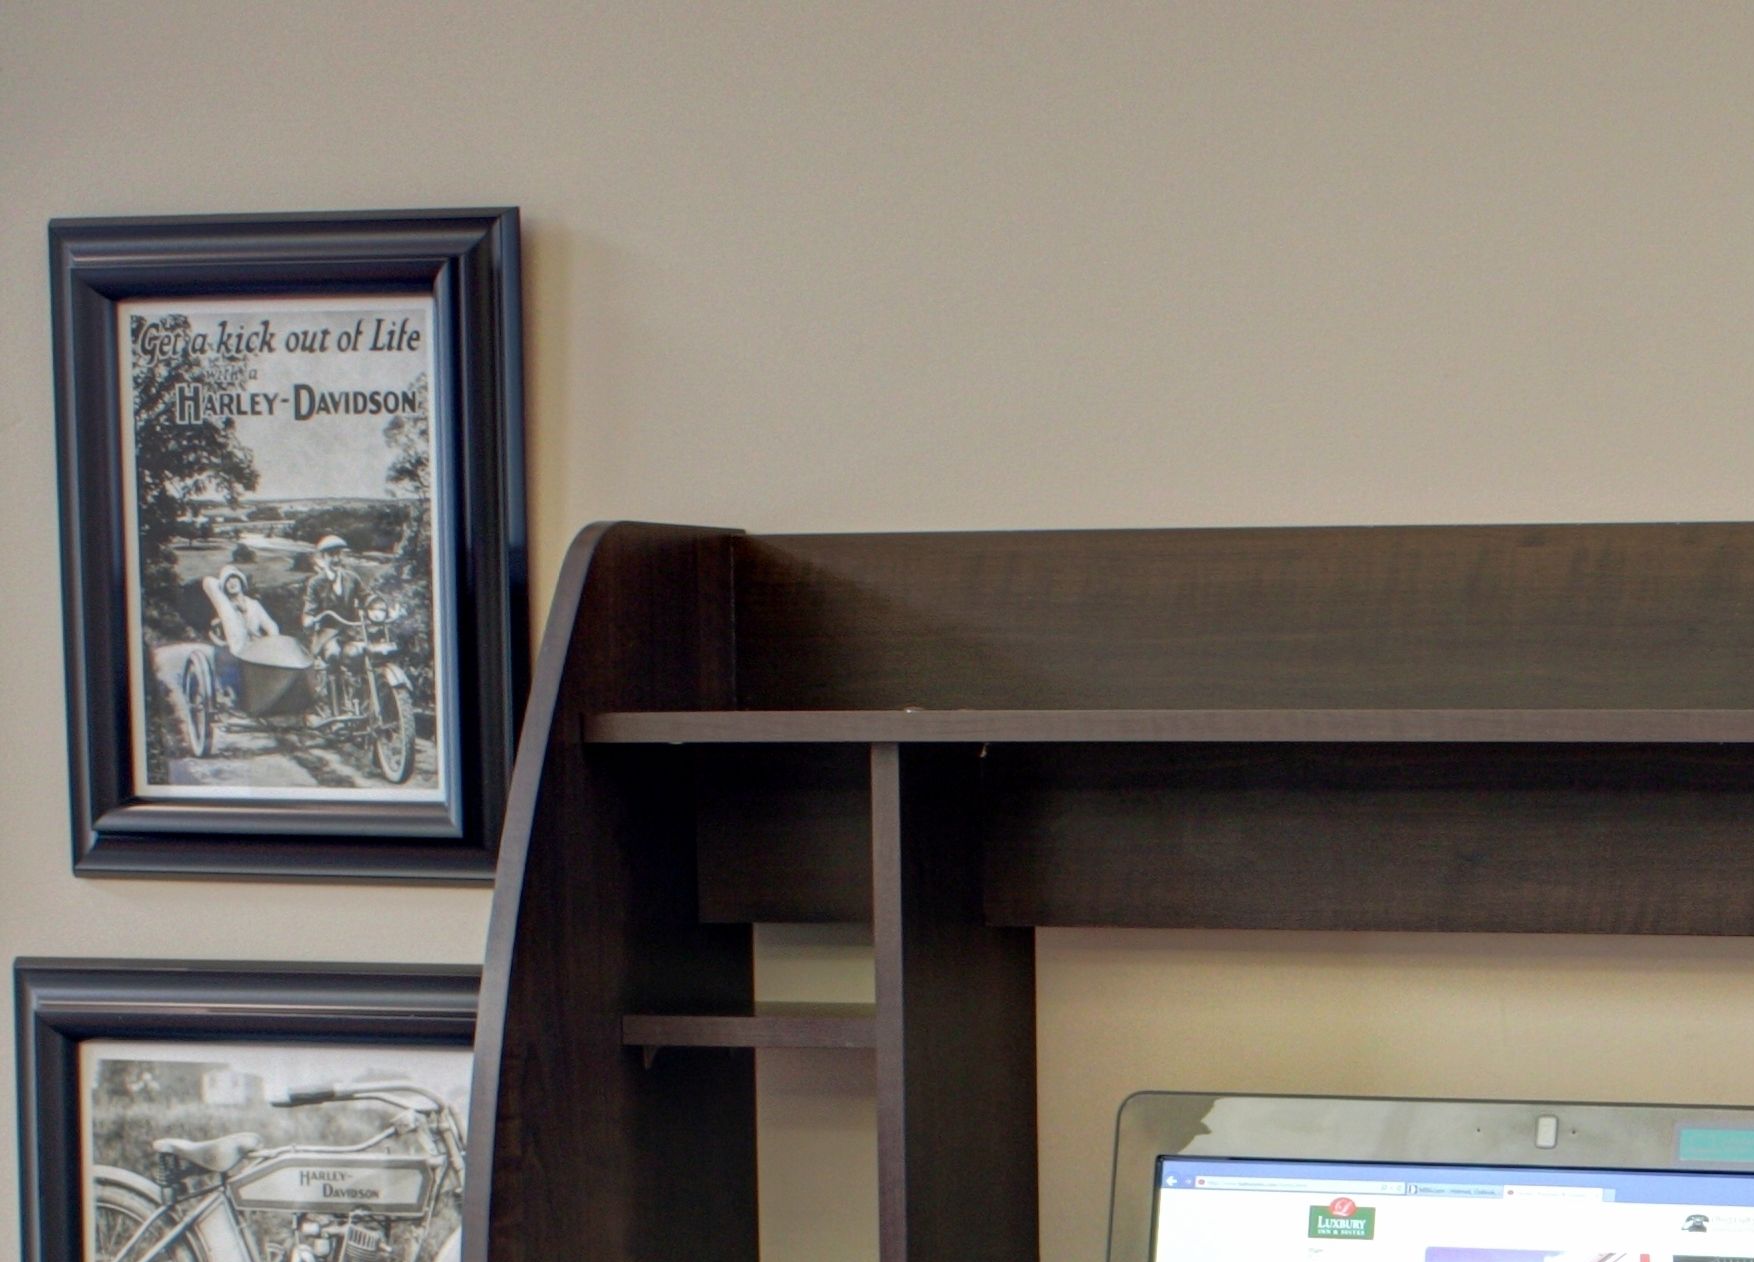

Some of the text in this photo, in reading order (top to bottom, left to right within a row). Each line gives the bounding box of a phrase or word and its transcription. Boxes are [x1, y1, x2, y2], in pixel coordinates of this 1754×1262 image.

[140, 318, 421, 365] Get a kick out of Life
[176, 383, 420, 424] HARLEY-DAVIDSON
[322, 1183, 379, 1198] DAVIDSON
[1318, 1216, 1366, 1229] LUXBURY
